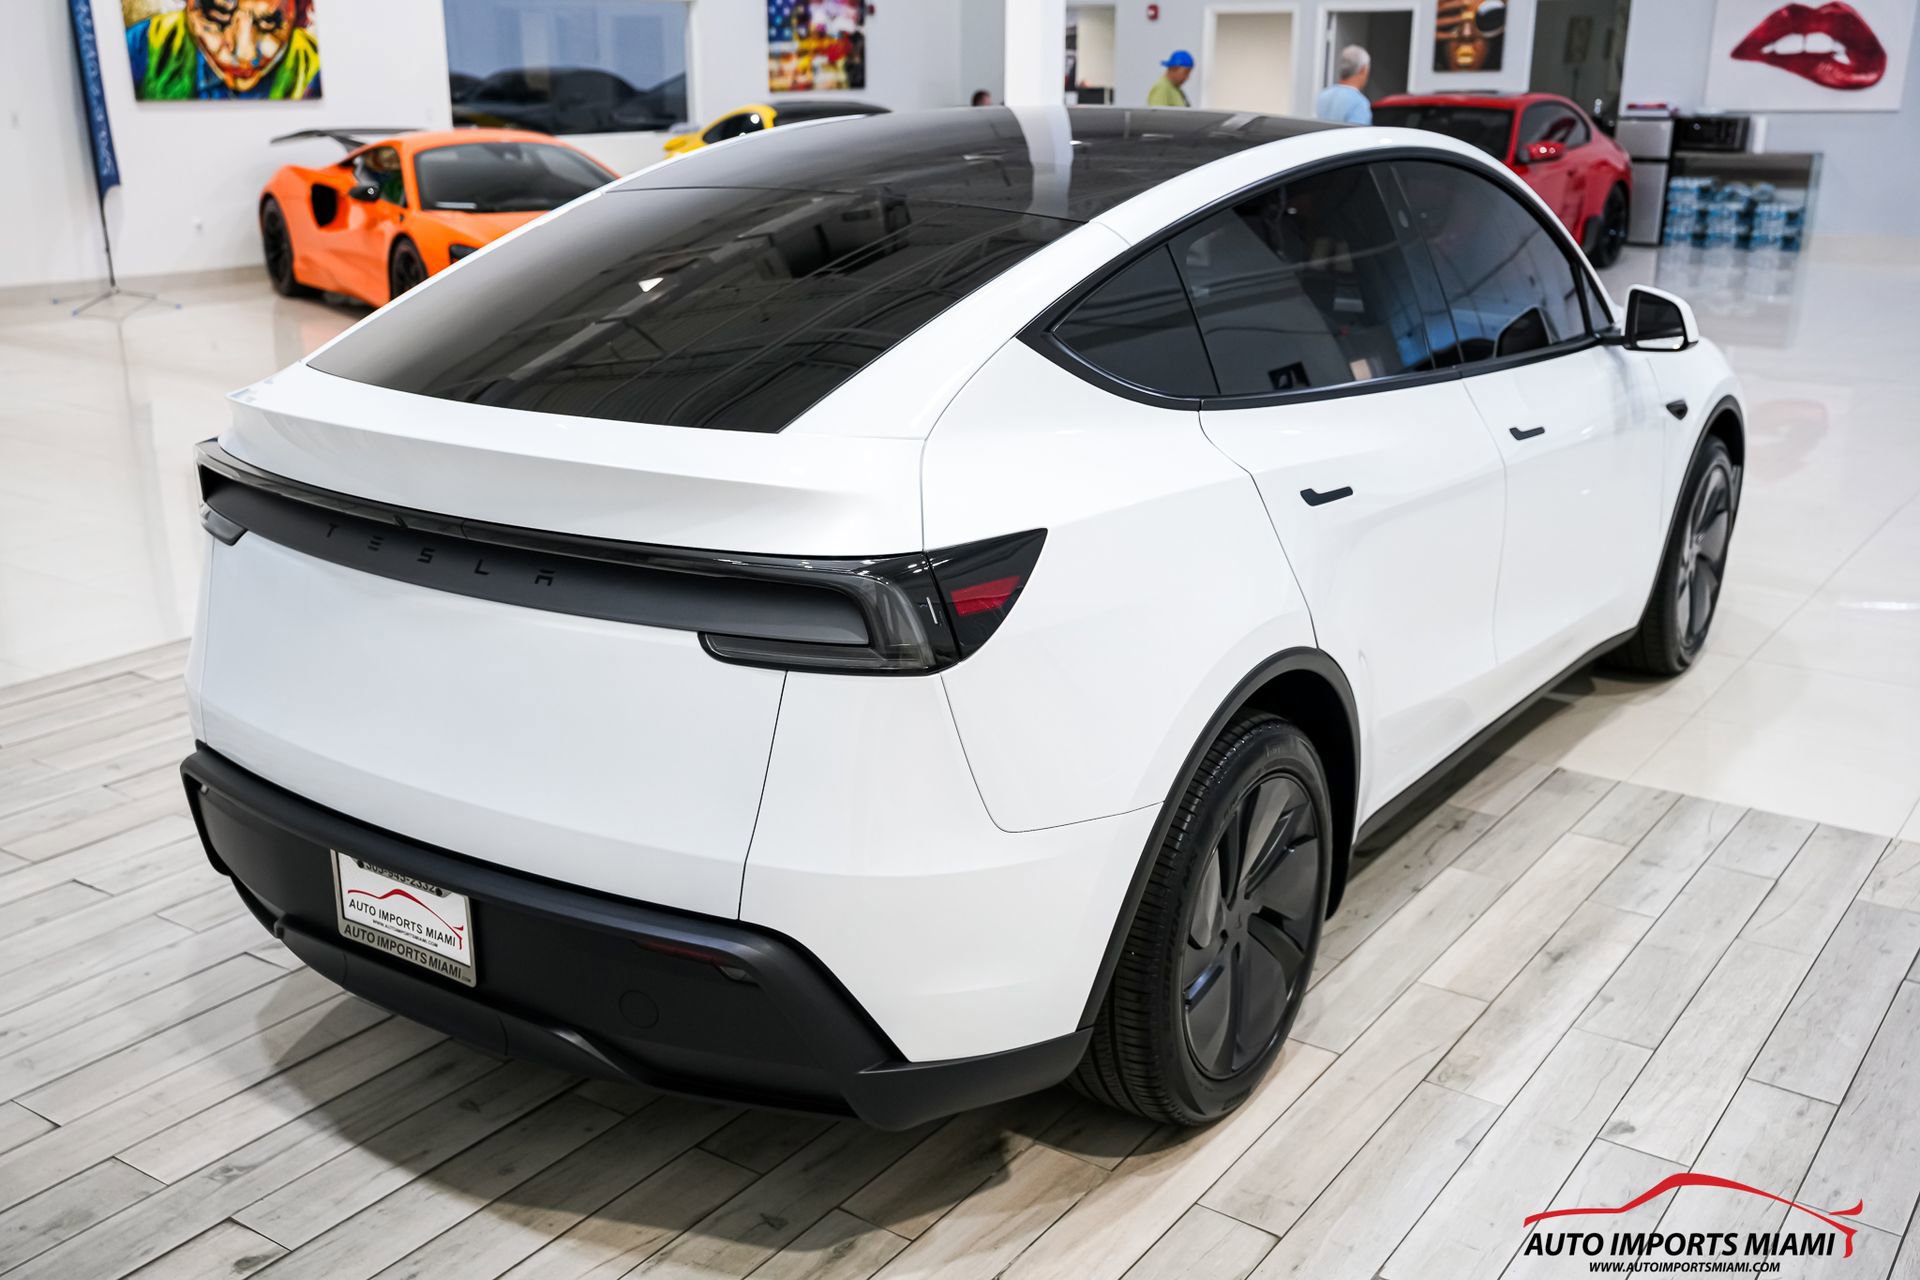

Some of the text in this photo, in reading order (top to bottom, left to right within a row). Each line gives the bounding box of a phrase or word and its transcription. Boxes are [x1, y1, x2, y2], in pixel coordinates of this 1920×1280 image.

[326, 523, 555, 586] TESLA
[344, 924, 376, 943] AUTO
[377, 936, 427, 965] IMPORTS
[345, 898, 456, 947] AUTO IMPORTS MIAMI
